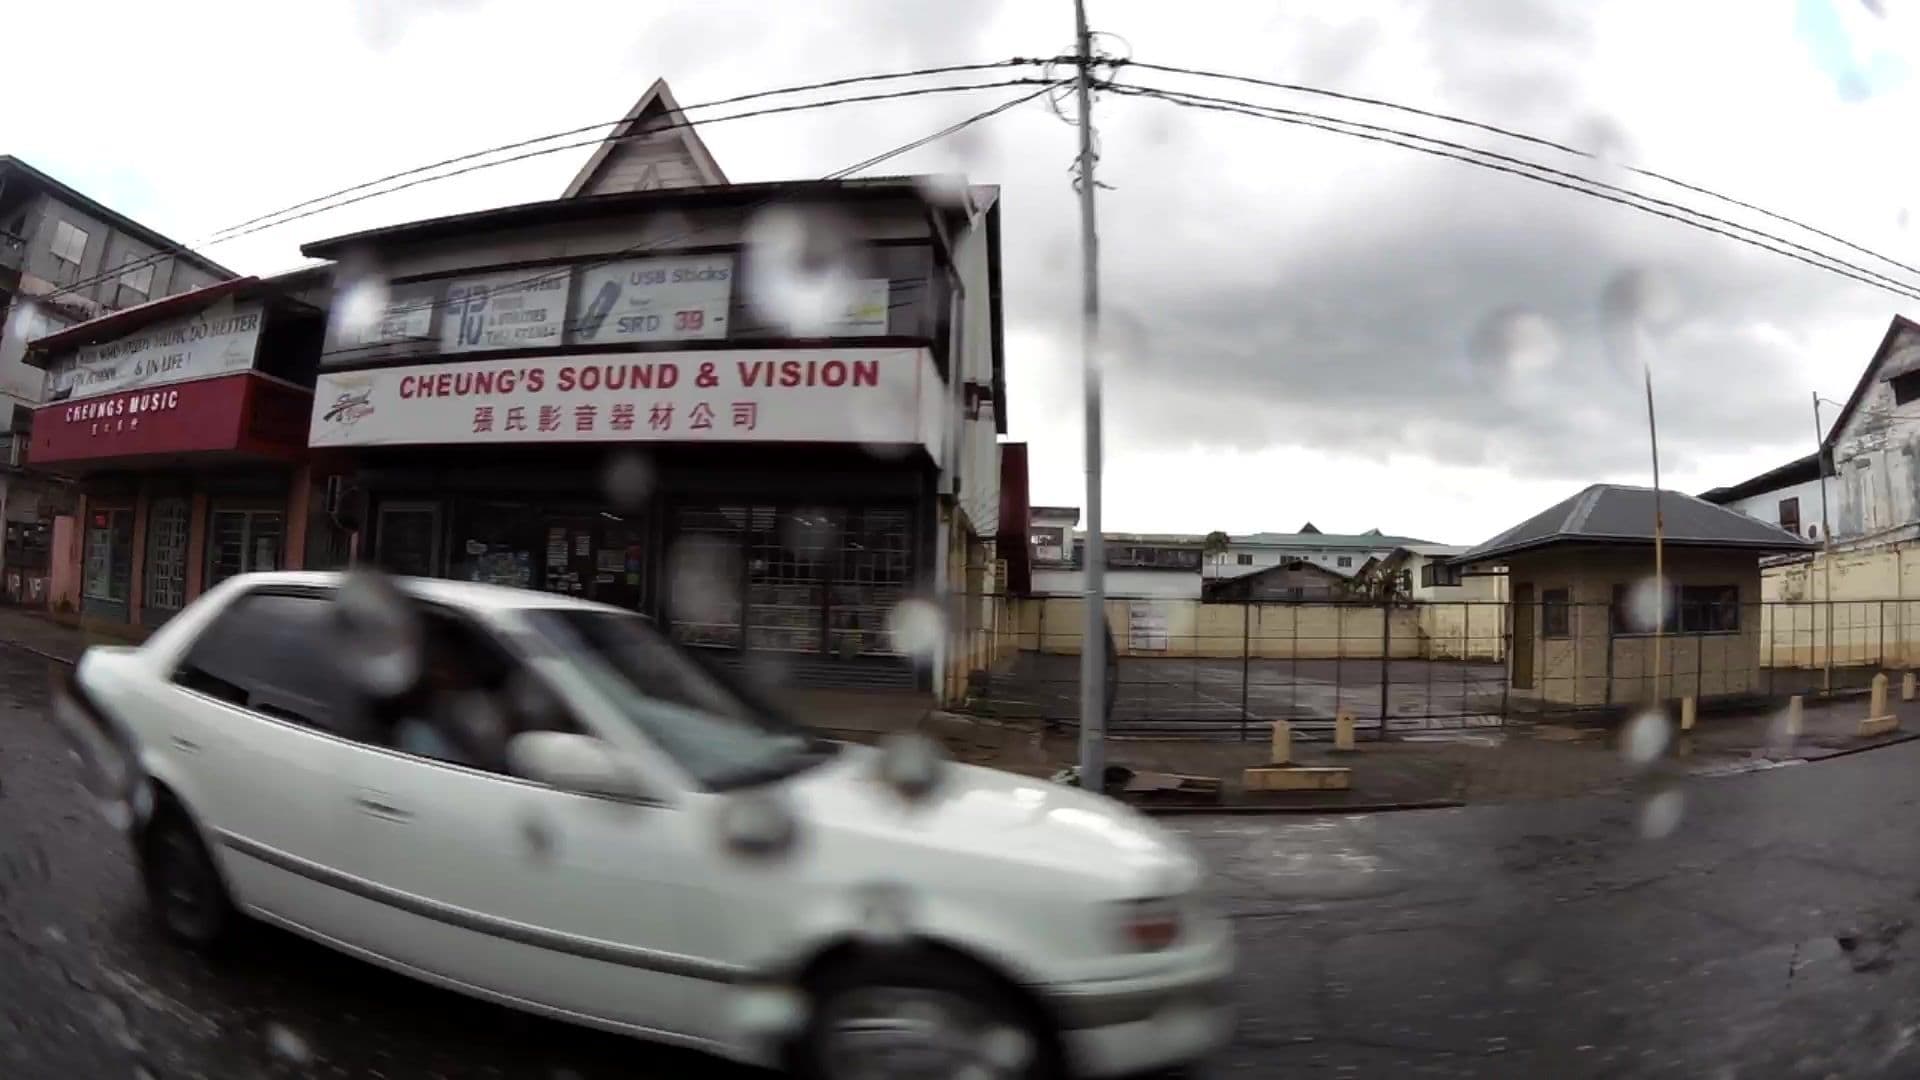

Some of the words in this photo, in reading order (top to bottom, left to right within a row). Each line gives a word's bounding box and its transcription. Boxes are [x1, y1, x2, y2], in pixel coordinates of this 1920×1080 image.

[630, 271, 665, 286] USB
[616, 314, 660, 332] SRD
[399, 367, 545, 399] CHEUNG'S
[557, 362, 680, 392] SOUND
[694, 361, 720, 388] &
[736, 359, 880, 388] VISION
[128, 390, 179, 413] MUSIC
[472, 400, 759, 434] 張氏影音器材公司
